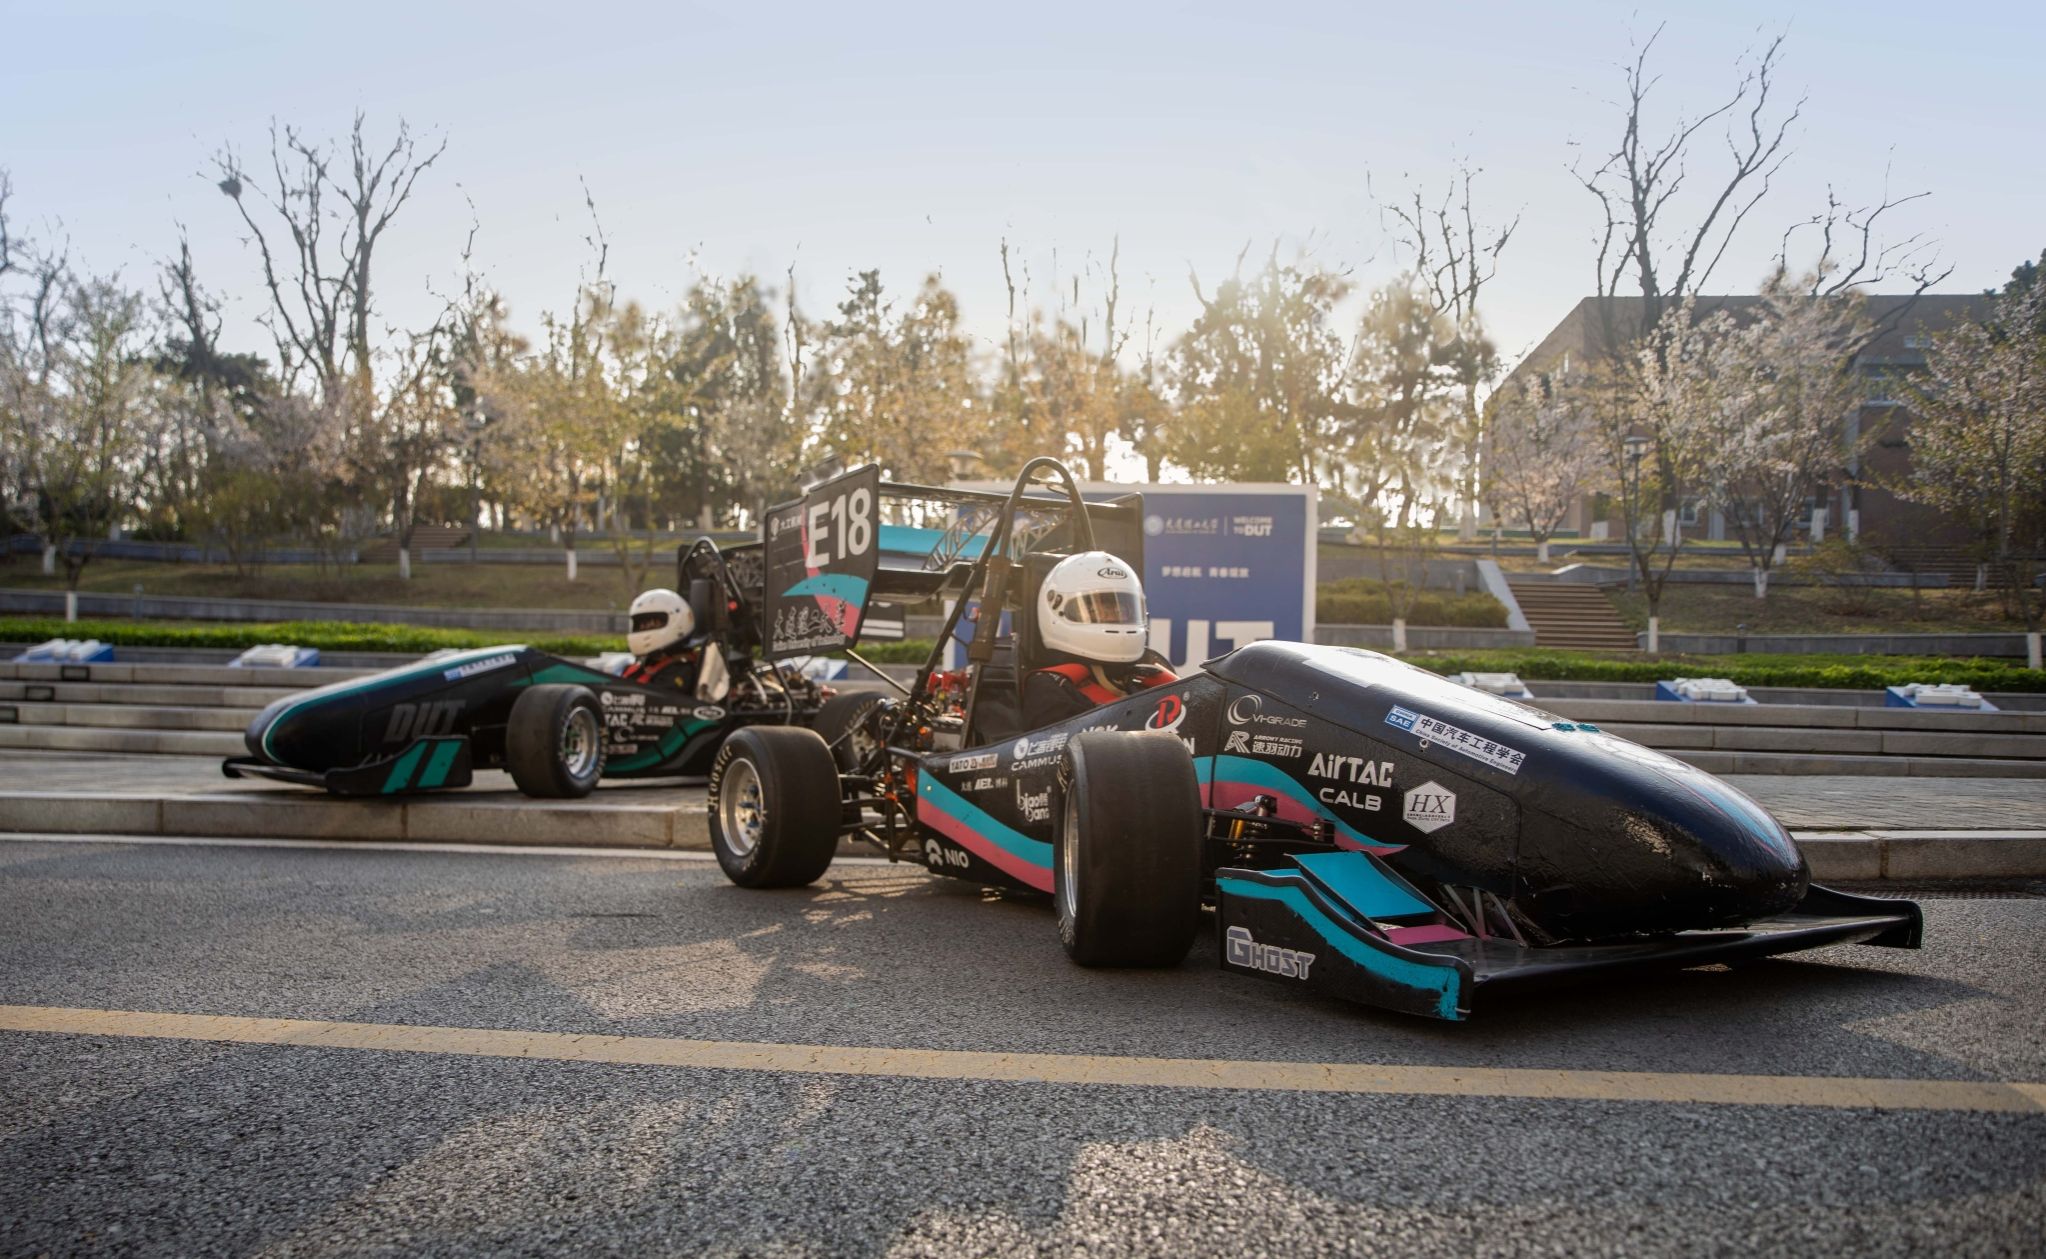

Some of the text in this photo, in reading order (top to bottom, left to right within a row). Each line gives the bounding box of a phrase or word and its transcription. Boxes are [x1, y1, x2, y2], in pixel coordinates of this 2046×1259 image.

[807, 487, 872, 569] E18
[1244, 525, 1272, 536] DUT
[1150, 618, 1274, 679] UT
[1252, 714, 1308, 728] VI-GRADE
[1389, 714, 1411, 728] SAE
[1252, 740, 1302, 758] 速羽动力
[1415, 729, 1430, 739] China
[1431, 735, 1451, 748] Society
[1459, 745, 1489, 762] Automotive
[1489, 757, 1517, 773] Engineers
[1420, 718, 1524, 766] 中国汽车工程学会
[1010, 754, 1063, 771] CAMMUS
[1319, 787, 1382, 812] CALB
[1409, 794, 1451, 813] HX
[944, 848, 969, 868] NIO
